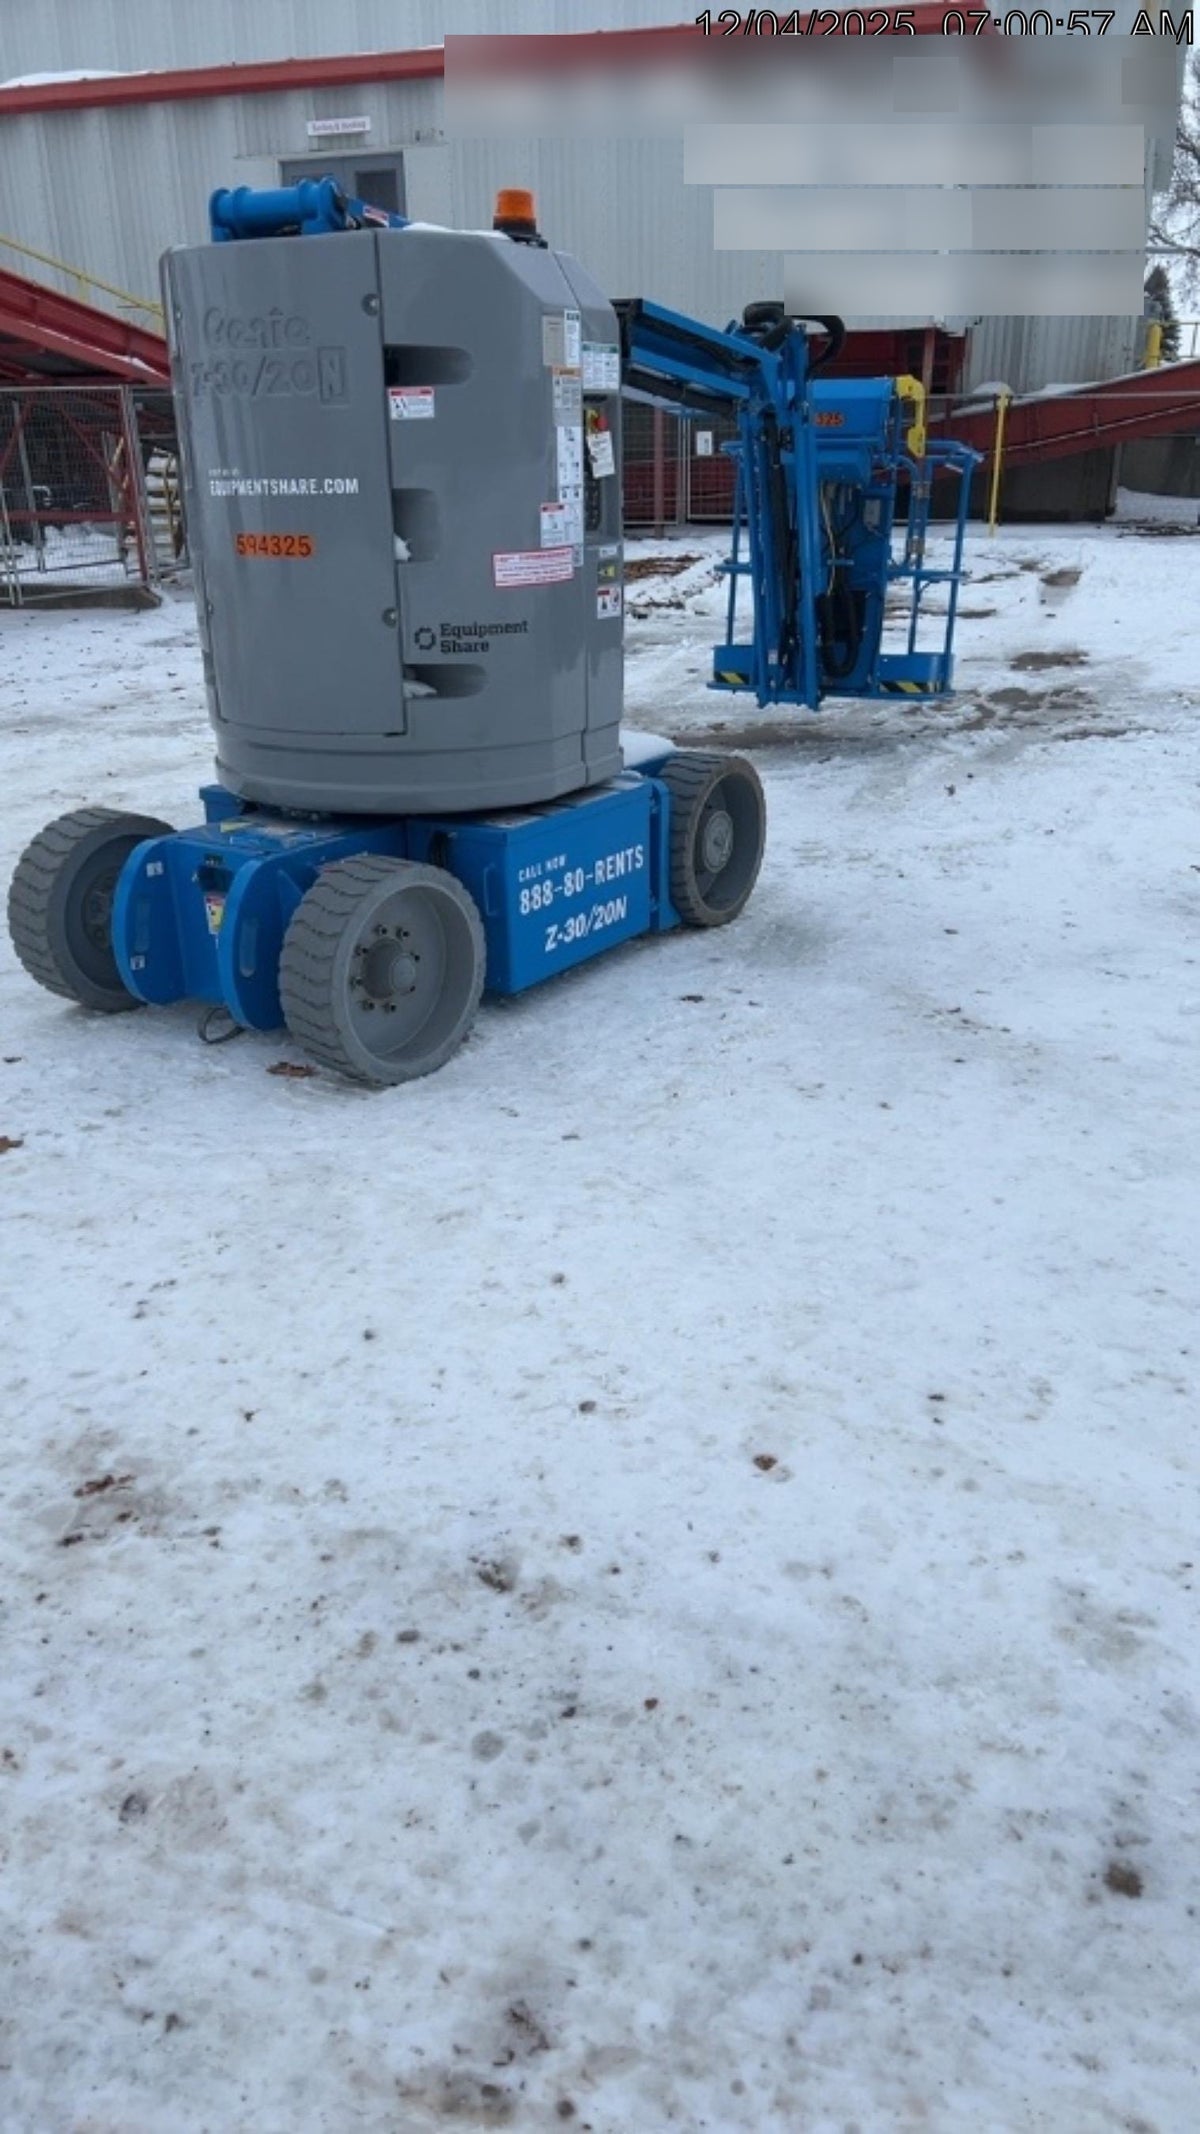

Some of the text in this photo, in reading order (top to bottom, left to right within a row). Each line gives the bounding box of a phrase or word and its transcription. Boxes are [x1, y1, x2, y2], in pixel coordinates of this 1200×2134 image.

[210, 478, 359, 497] EQUIPMENTSHARE.COM
[236, 533, 312, 557] 594325
[440, 620, 528, 639] Equipment
[440, 639, 490, 654] Share
[518, 854, 567, 883] CALL NOW
[519, 844, 644, 916] 888-80-RENTS
[544, 895, 628, 953] Z-30/20N
